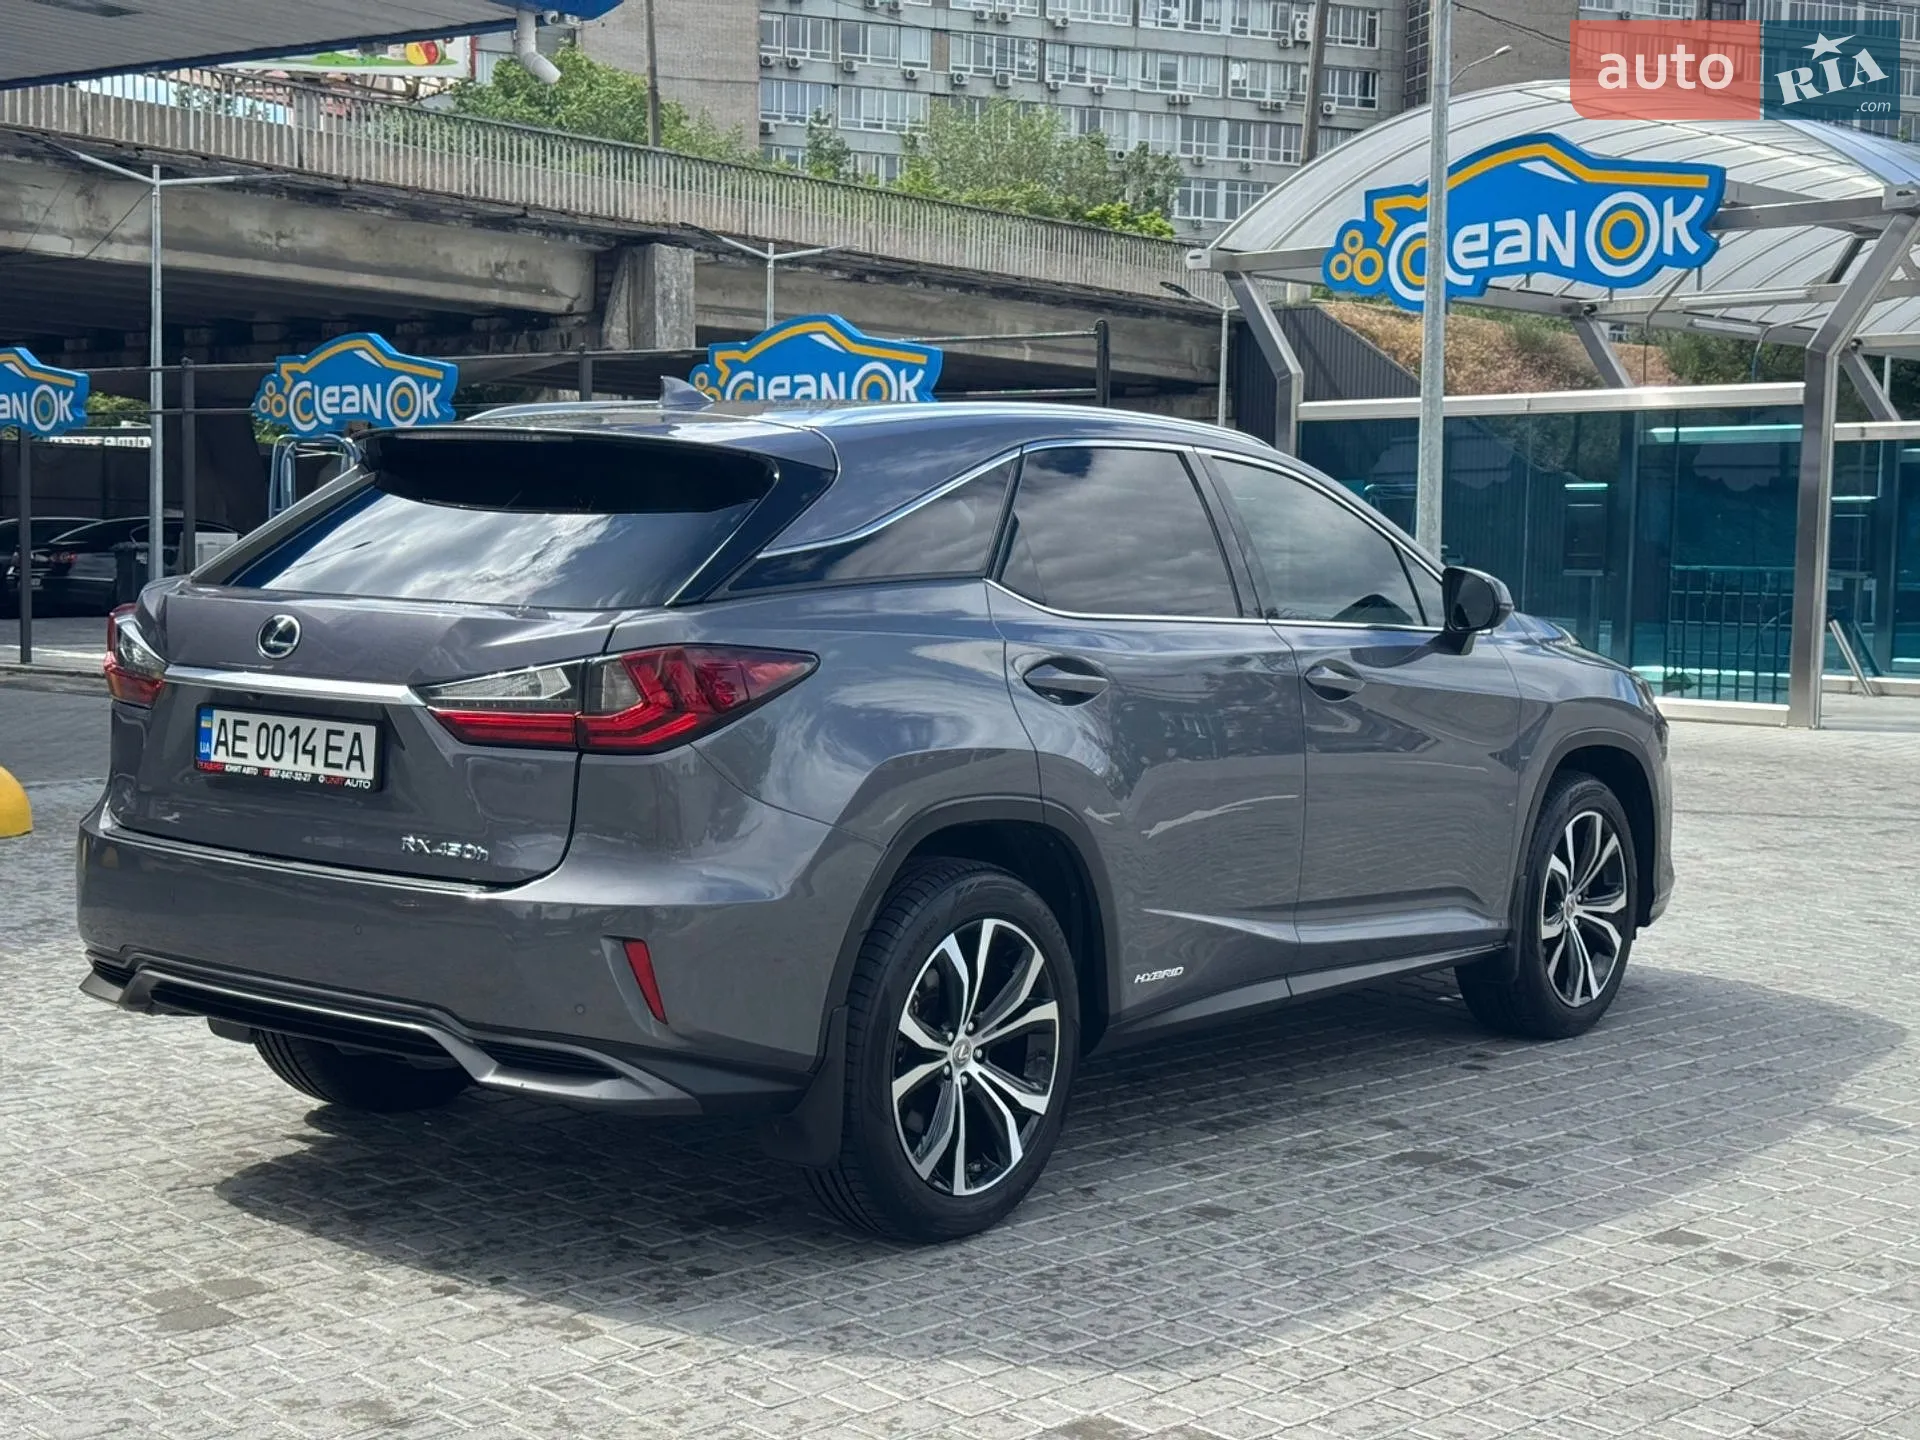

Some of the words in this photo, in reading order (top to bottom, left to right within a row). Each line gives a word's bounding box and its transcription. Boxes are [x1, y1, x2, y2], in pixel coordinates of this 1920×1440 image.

[213, 717, 250, 759] AE
[255, 721, 317, 767] 0014
[323, 728, 366, 773] EA
[401, 834, 431, 854] RX
[1134, 966, 1185, 984] HYBRID
